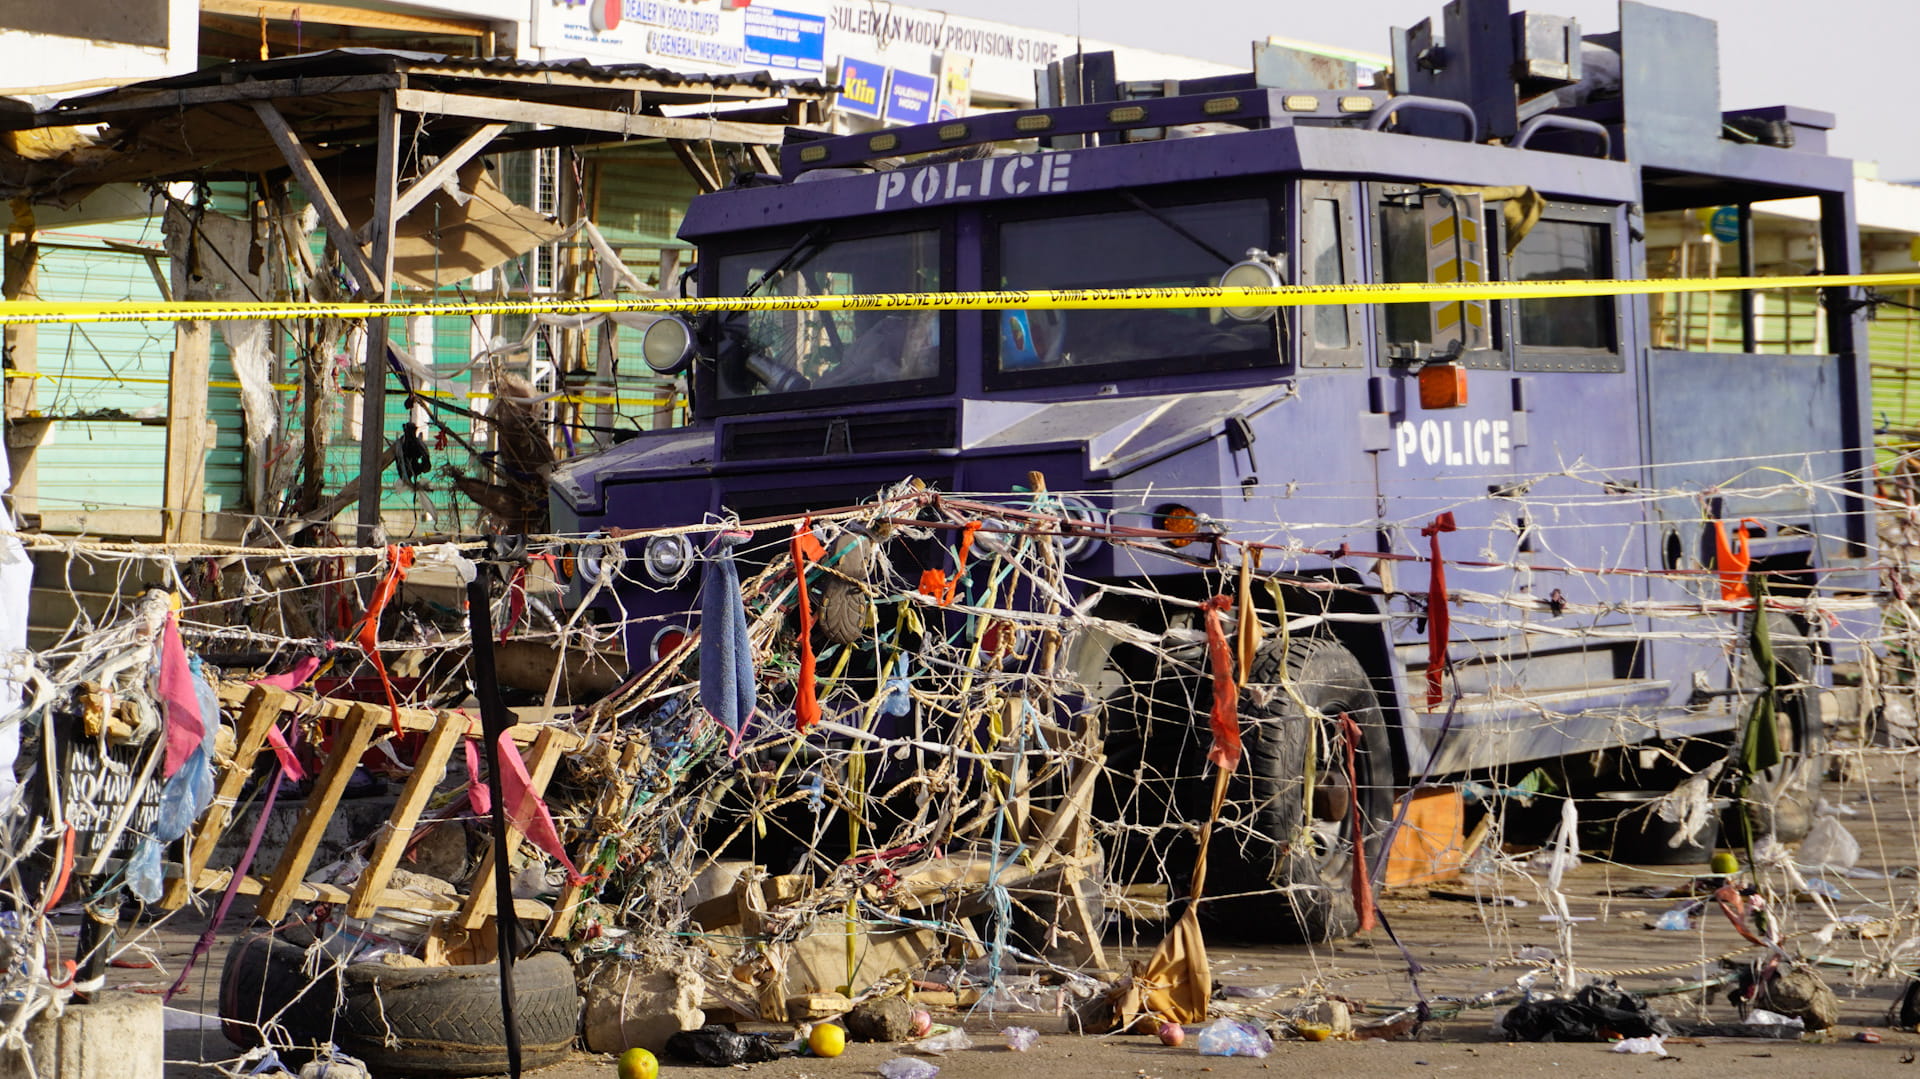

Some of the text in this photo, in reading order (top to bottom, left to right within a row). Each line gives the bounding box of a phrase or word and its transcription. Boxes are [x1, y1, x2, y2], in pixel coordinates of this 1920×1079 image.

[626, 0, 657, 21] DEALER
[668, 7, 687, 28] FOOD
[660, 33, 697, 57] GENERAL
[699, 41, 743, 65] MERCHANT
[945, 25, 1014, 60] PROVISION
[1017, 38, 1058, 65] STORE
[843, 76, 876, 105] Klin
[875, 153, 1073, 211] POLICE
[615, 295, 820, 312] CRIME SCENE DO NOT CROSS
[842, 291, 1031, 308] CRIME SCENE DO NOT CROSS
[1396, 418, 1511, 467] POLICE
[71, 742, 99, 771] NO
[68, 772, 99, 802] NO
